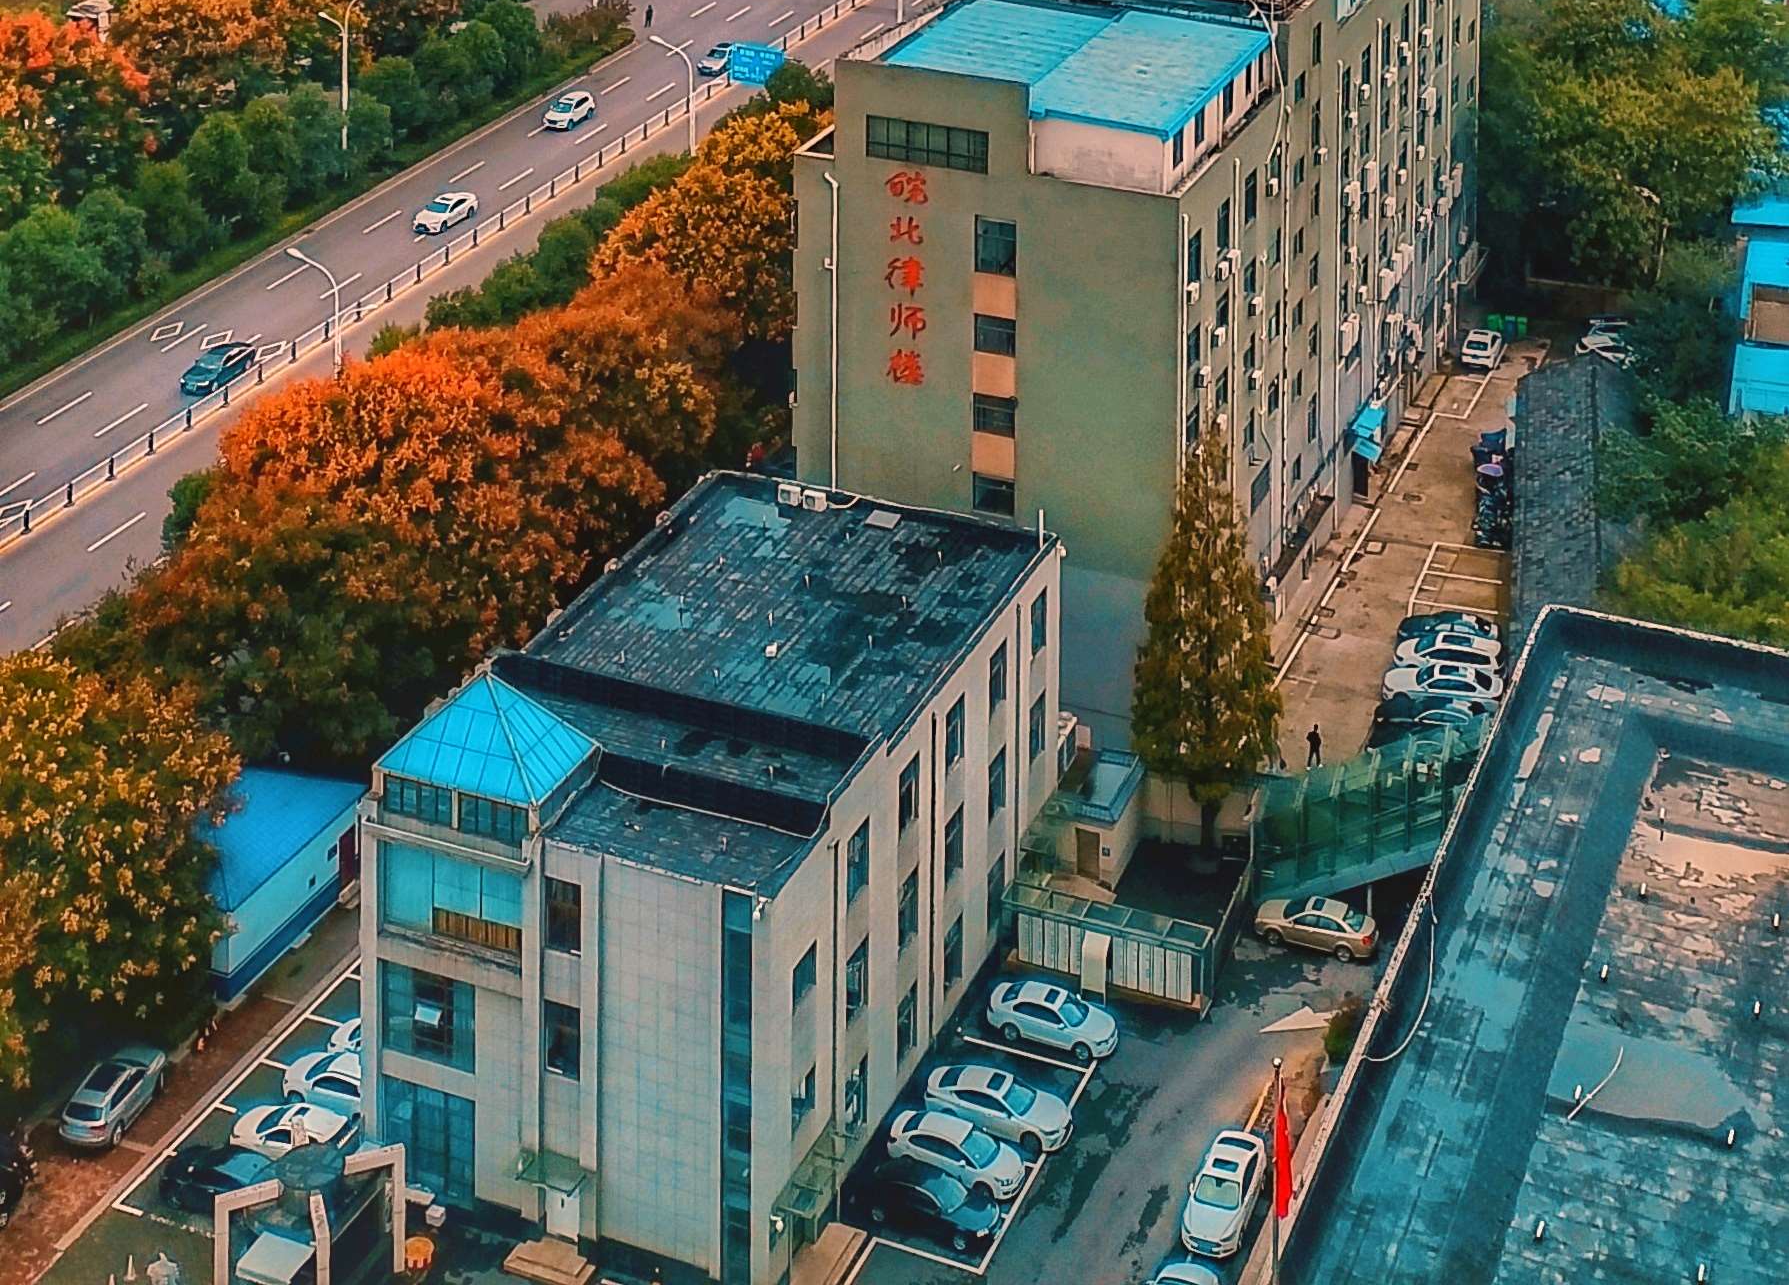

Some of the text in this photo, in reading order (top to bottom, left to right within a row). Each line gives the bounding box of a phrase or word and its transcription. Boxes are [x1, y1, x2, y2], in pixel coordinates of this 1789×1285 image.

[884, 171, 929, 386] 皖北律师楼
